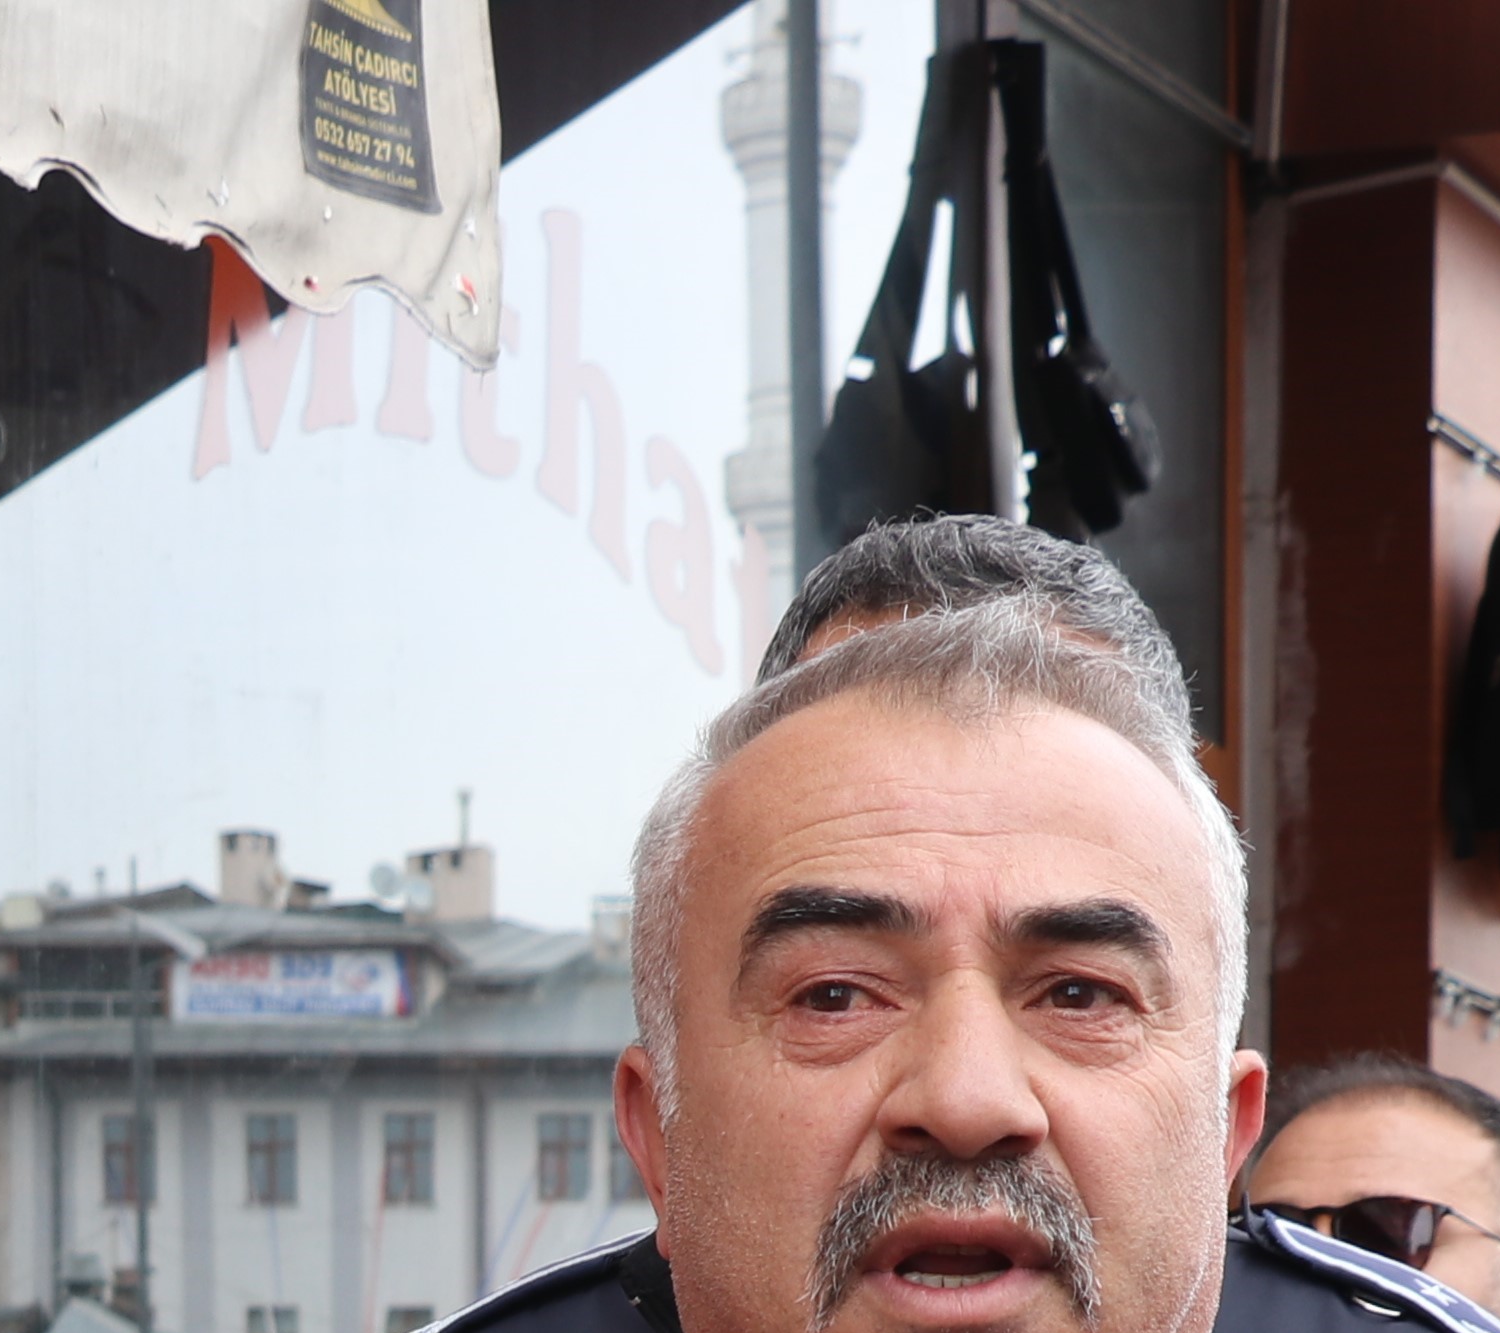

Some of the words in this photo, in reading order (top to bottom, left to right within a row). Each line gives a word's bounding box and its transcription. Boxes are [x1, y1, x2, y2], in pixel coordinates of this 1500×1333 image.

[309, 21, 353, 67] TAHSİN
[324, 68, 397, 117] ATÖLYESİ
[314, 116, 345, 149] 0532
[346, 129, 371, 157] 657
[372, 137, 391, 163] 27
[395, 143, 415, 168] 94
